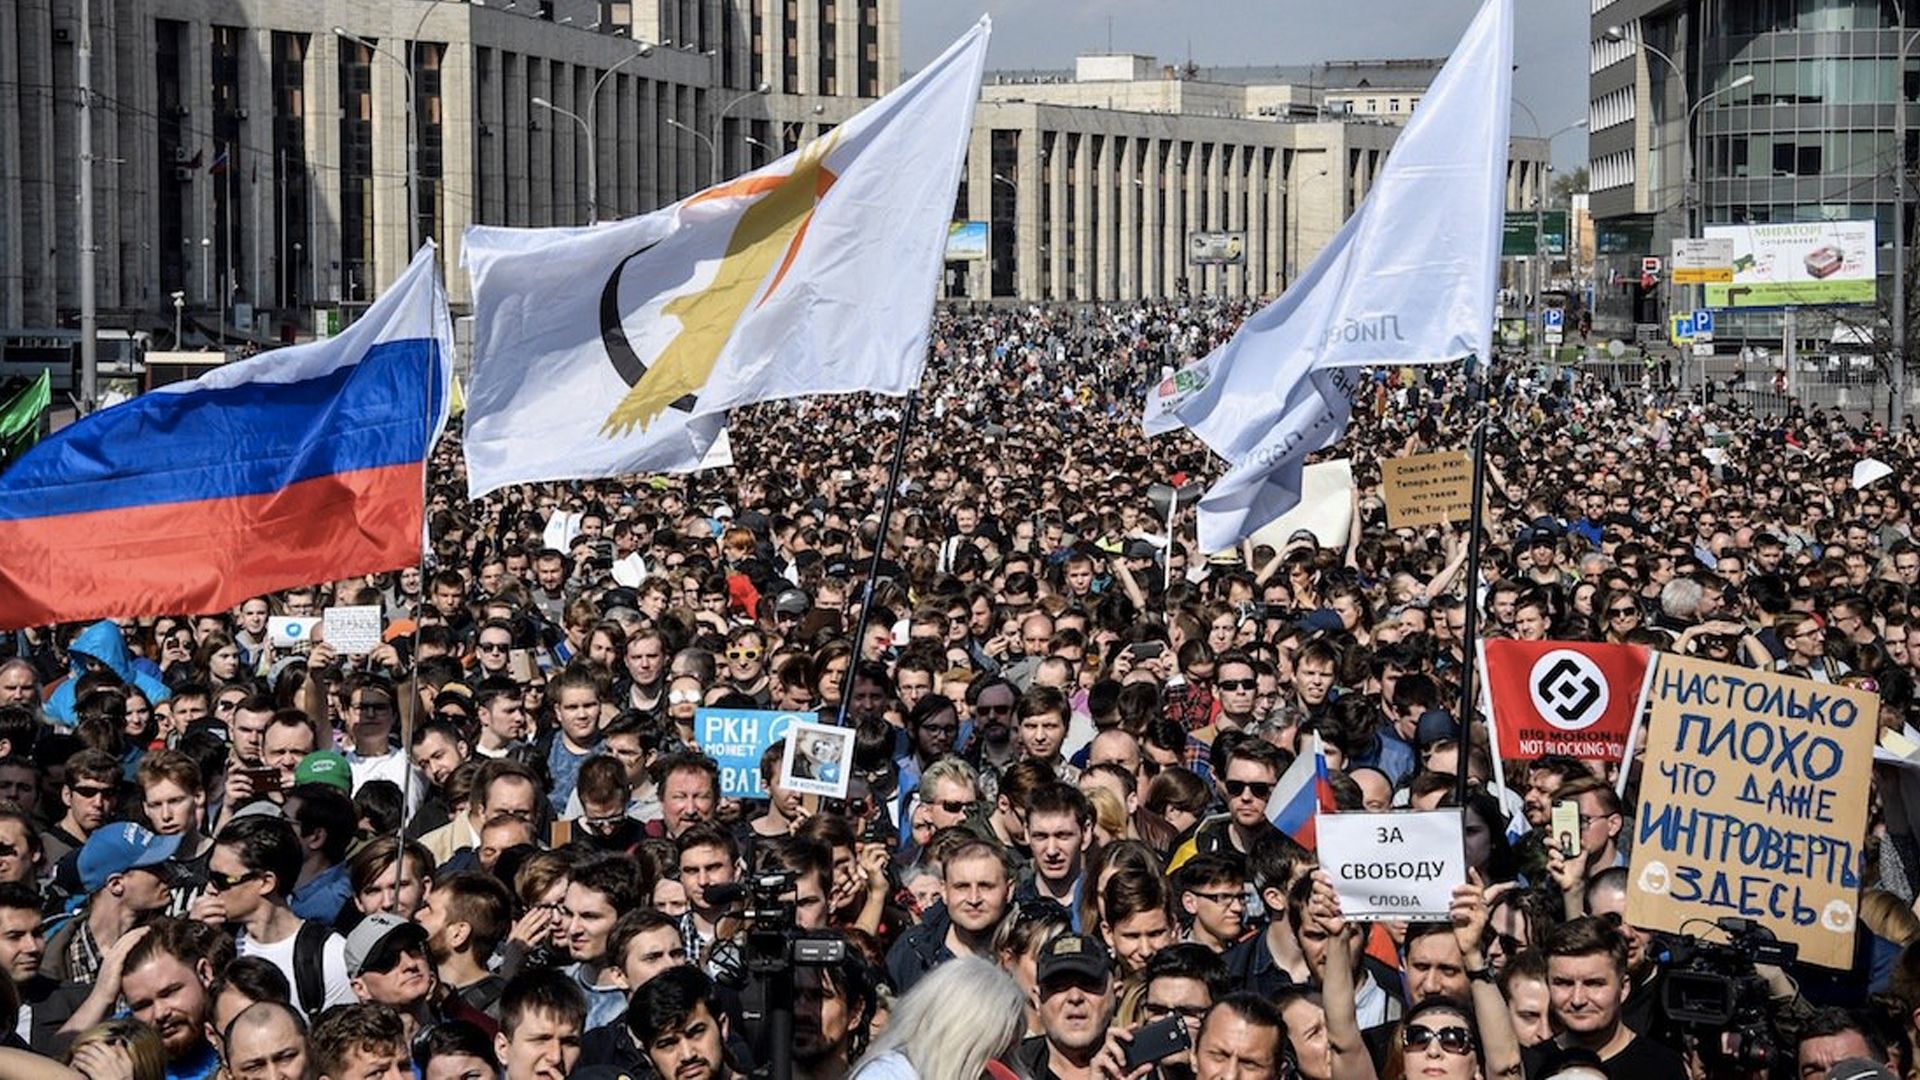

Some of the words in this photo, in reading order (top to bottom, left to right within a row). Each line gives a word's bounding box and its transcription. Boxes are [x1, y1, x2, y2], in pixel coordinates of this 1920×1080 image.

[1697, 312, 1708, 330] P
[1661, 668, 1858, 728] НАСТОЛЬКО
[1520, 729, 1544, 740] BIG
[1551, 731, 1609, 741] MORON
[705, 743, 757, 756] МОЖЕТ
[1520, 740, 1544, 755] NOT
[1546, 741, 1605, 756] BLOCKING
[1675, 713, 1844, 781] ПЛОХО
[1660, 760, 1716, 797] ЧТО
[1735, 773, 1837, 823] ДАЖЕ
[1376, 827, 1404, 844] ЗА
[1639, 801, 1865, 888] ИНТРОВЕРТЫ
[1340, 861, 1445, 881] СВОБОДУ
[1369, 894, 1421, 907] СЛОВА
[1669, 865, 1817, 925] ЗДЕСЬ
